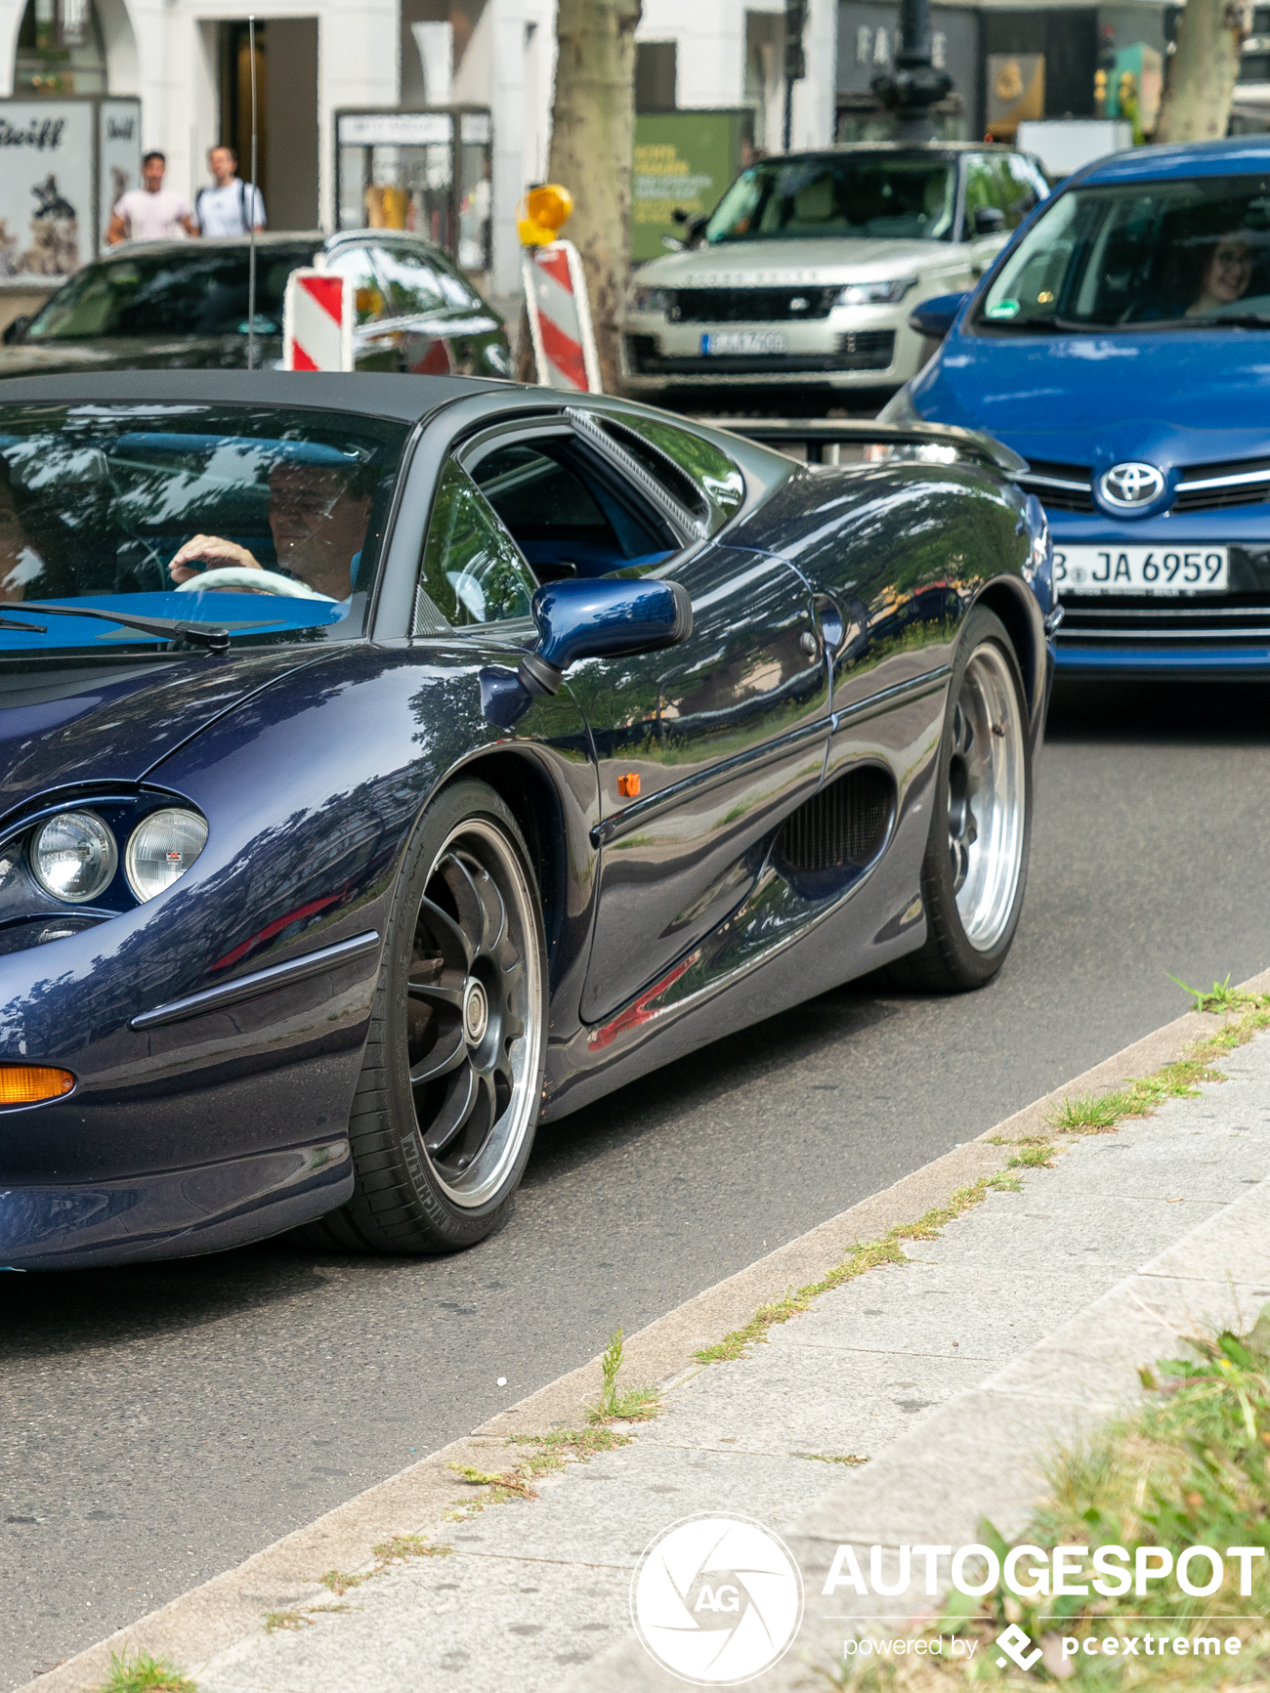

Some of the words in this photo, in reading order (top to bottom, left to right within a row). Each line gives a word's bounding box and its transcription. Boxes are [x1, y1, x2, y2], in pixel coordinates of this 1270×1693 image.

[1092, 552, 1131, 582] JA
[1142, 553, 1223, 583] 6959
[402, 1140, 450, 1230] MICHELIN
